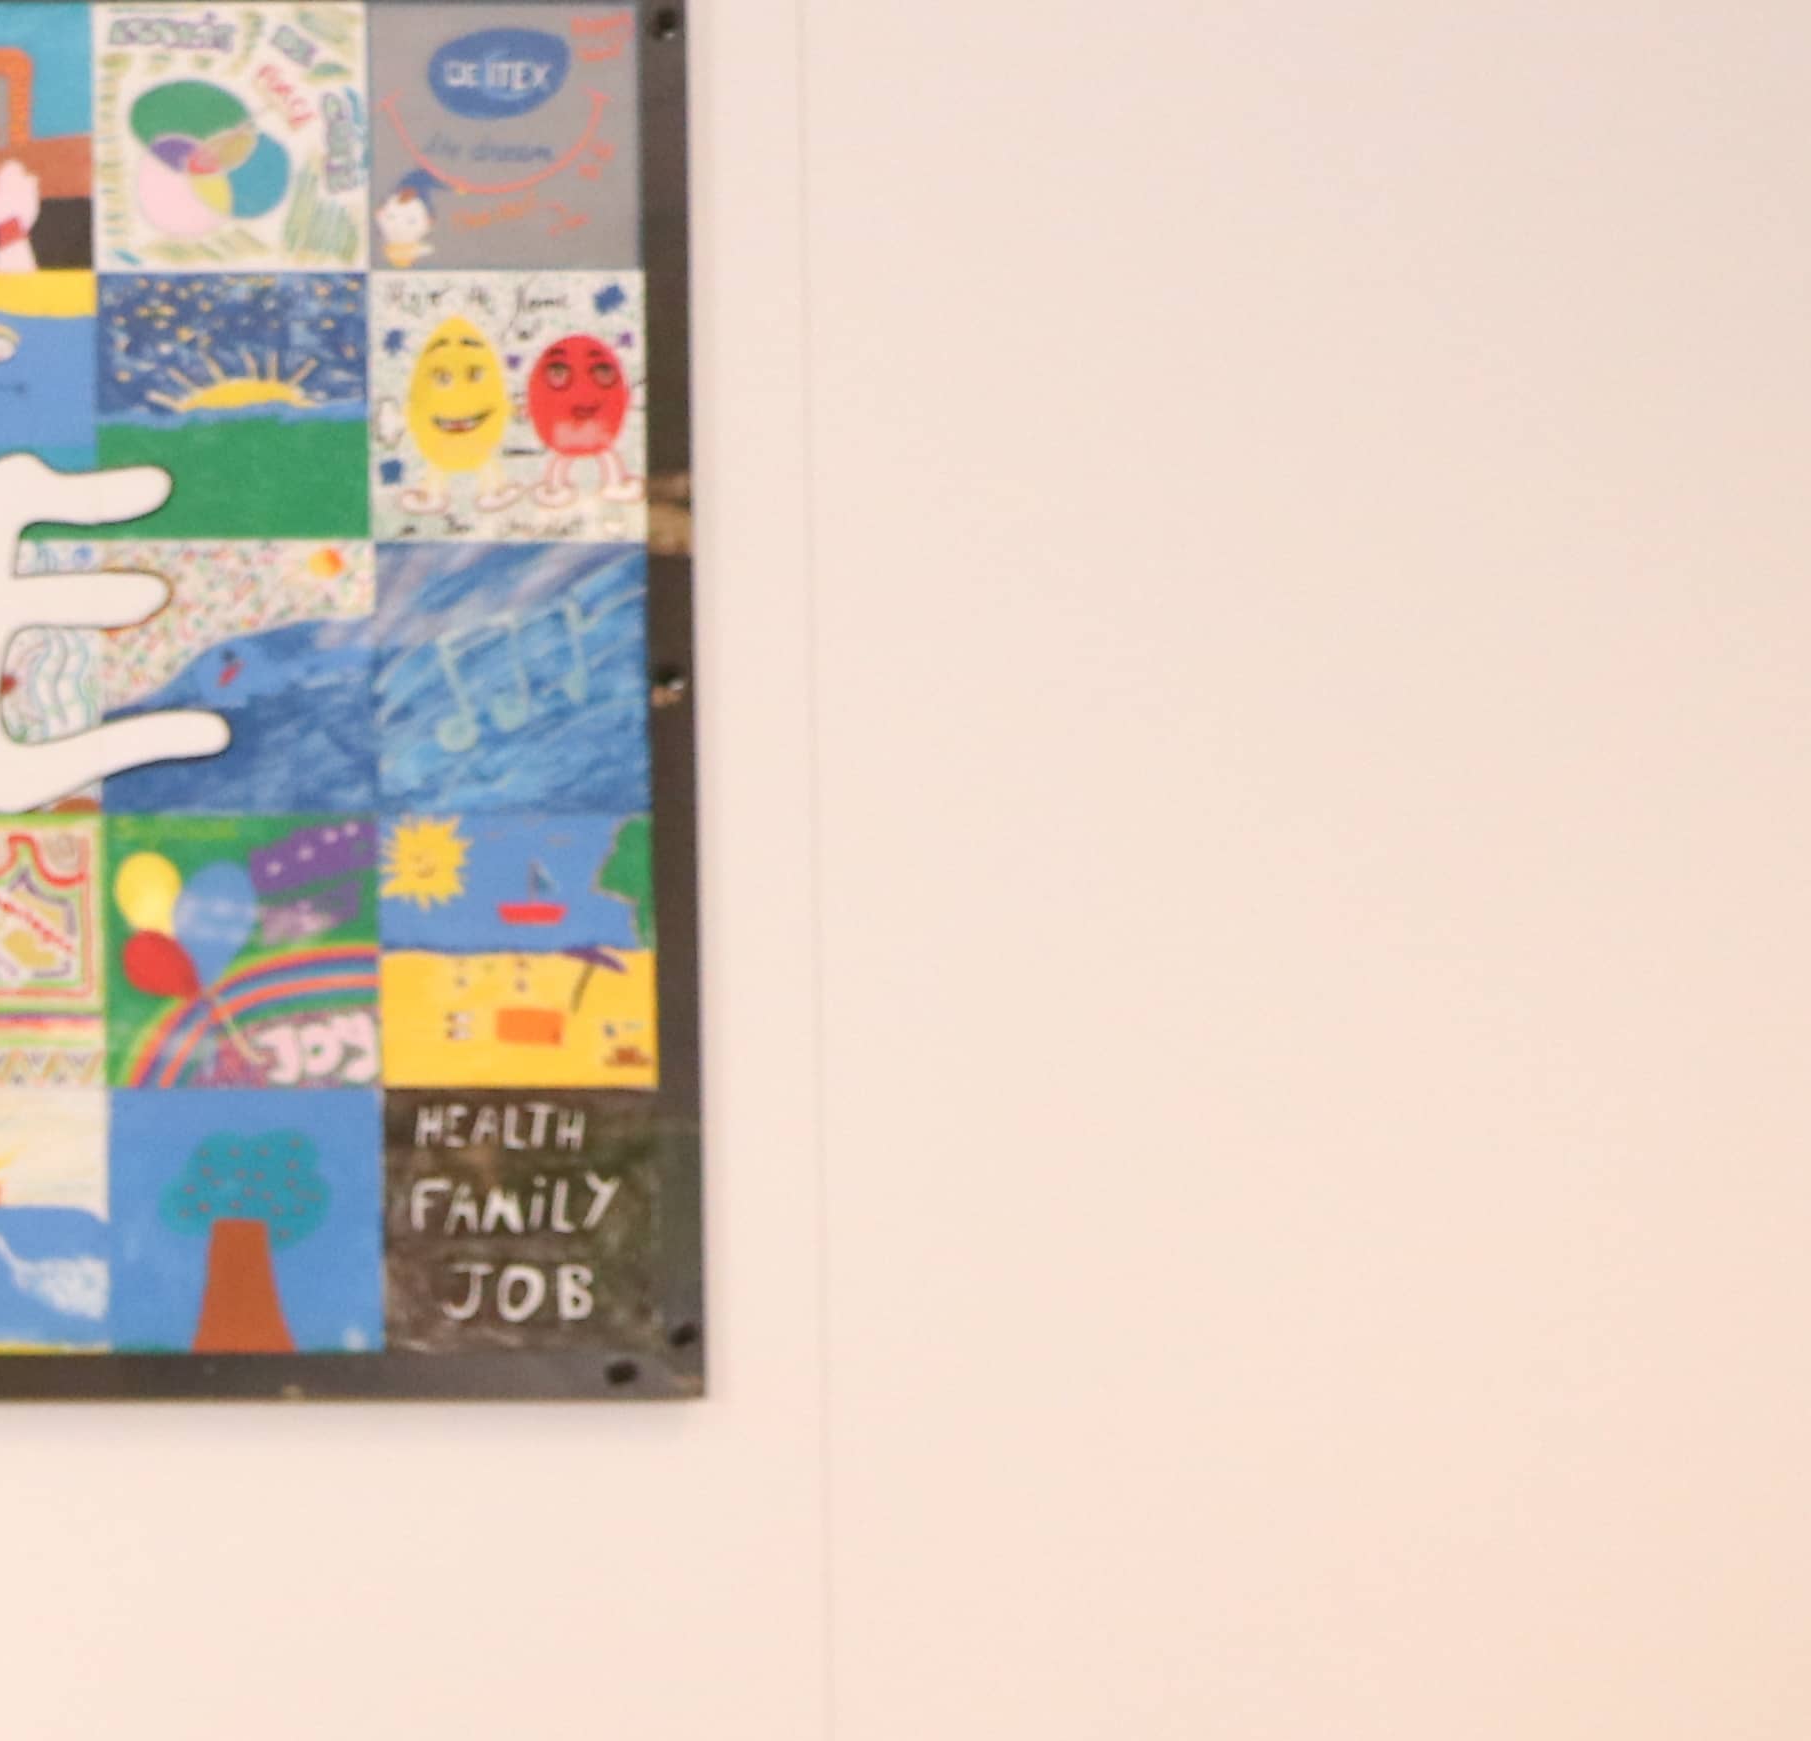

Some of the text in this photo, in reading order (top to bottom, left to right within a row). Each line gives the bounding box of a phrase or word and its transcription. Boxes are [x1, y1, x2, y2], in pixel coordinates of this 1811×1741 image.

[255, 1012, 379, 1085] JOY
[414, 1103, 586, 1150] HEALTH
[442, 1262, 594, 1323] JOB
